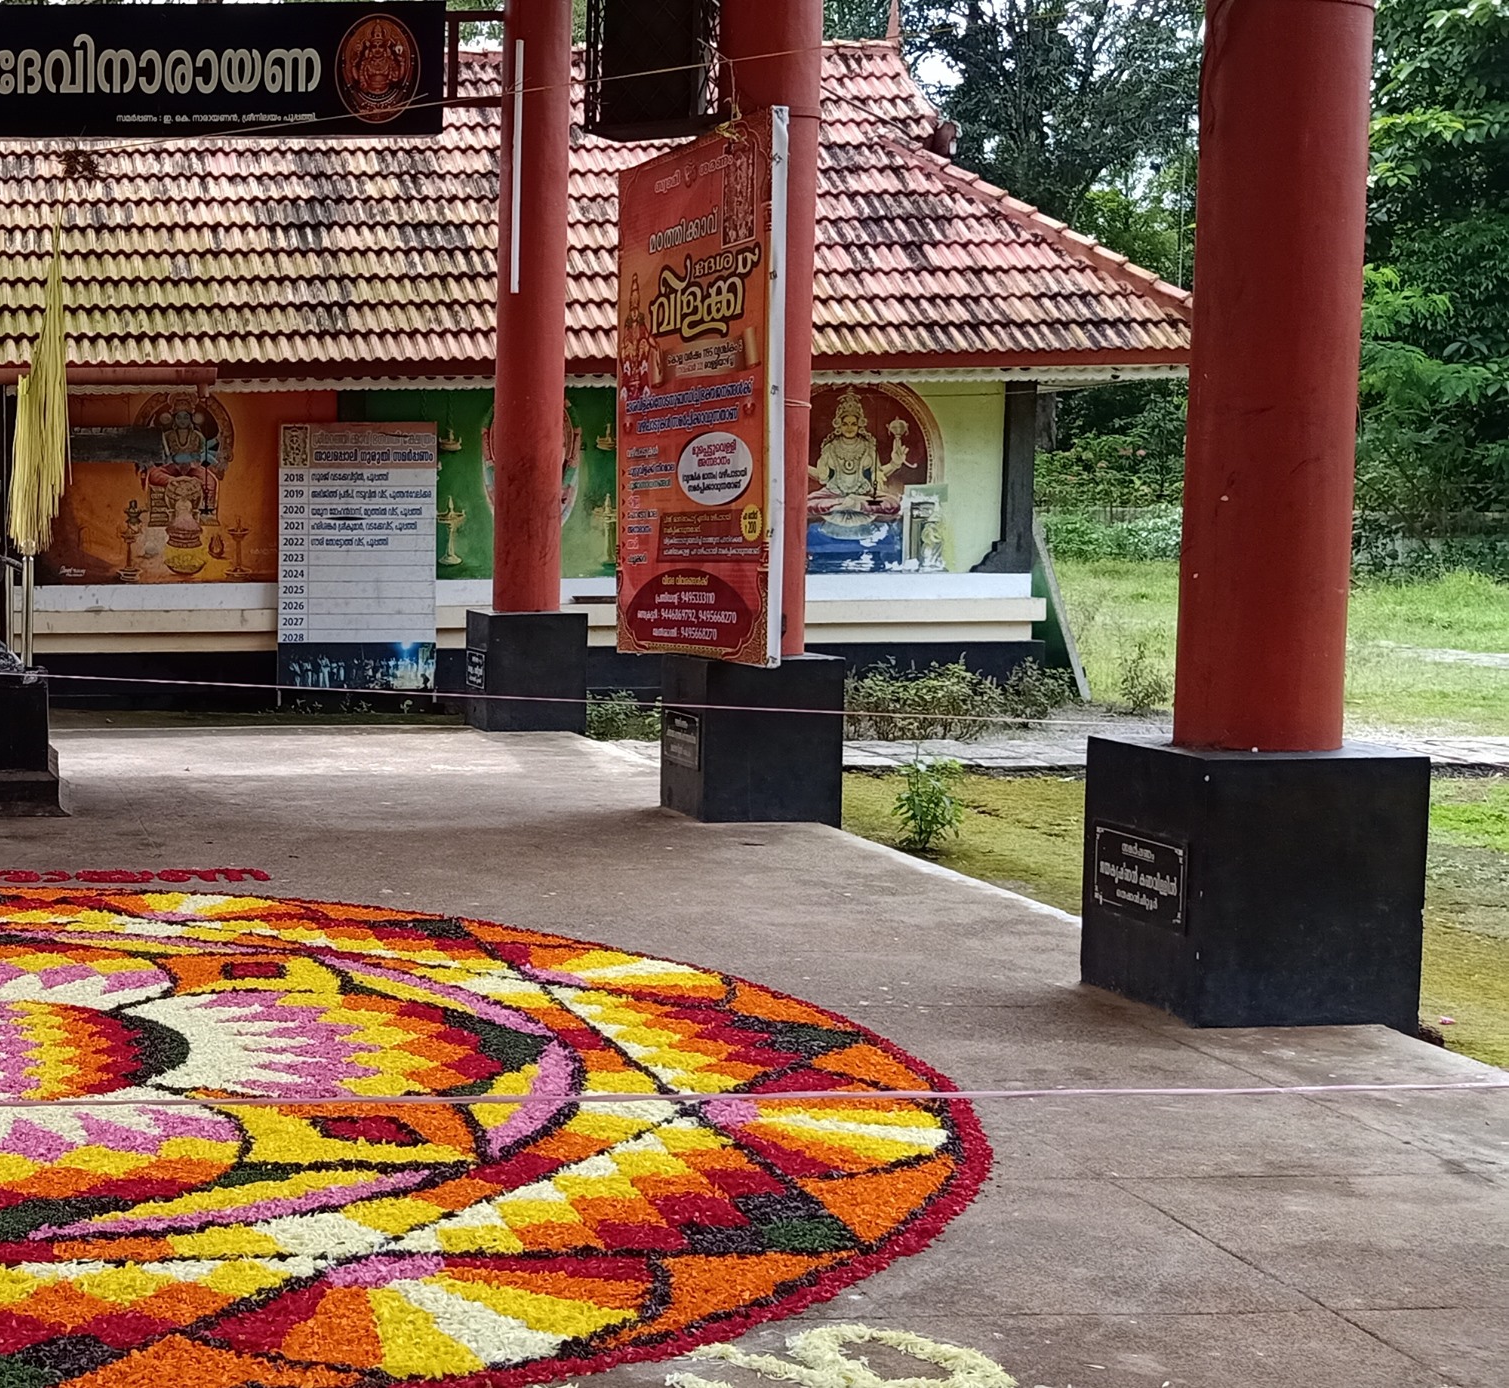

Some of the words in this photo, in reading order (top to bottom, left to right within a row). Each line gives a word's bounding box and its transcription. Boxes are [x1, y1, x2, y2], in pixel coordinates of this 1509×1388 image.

[693, 253, 734, 278] ദേശ
[391, 448, 435, 463] സമർപ്പണം
[283, 473, 305, 482] 2018
[283, 489, 305, 499] 2019
[282, 505, 306, 515] 2020
[283, 521, 305, 531] 2021
[282, 537, 305, 547] 2022
[282, 553, 305, 563] 2023
[282, 569, 305, 578] 2024
[282, 585, 305, 594] 2025
[680, 591, 716, 605] 9495333110
[282, 601, 305, 611] 2026
[282, 617, 305, 626] 2027
[698, 609, 738, 624] 9495668270
[282, 633, 305, 642] 2028
[680, 626, 718, 641] 9495668270
